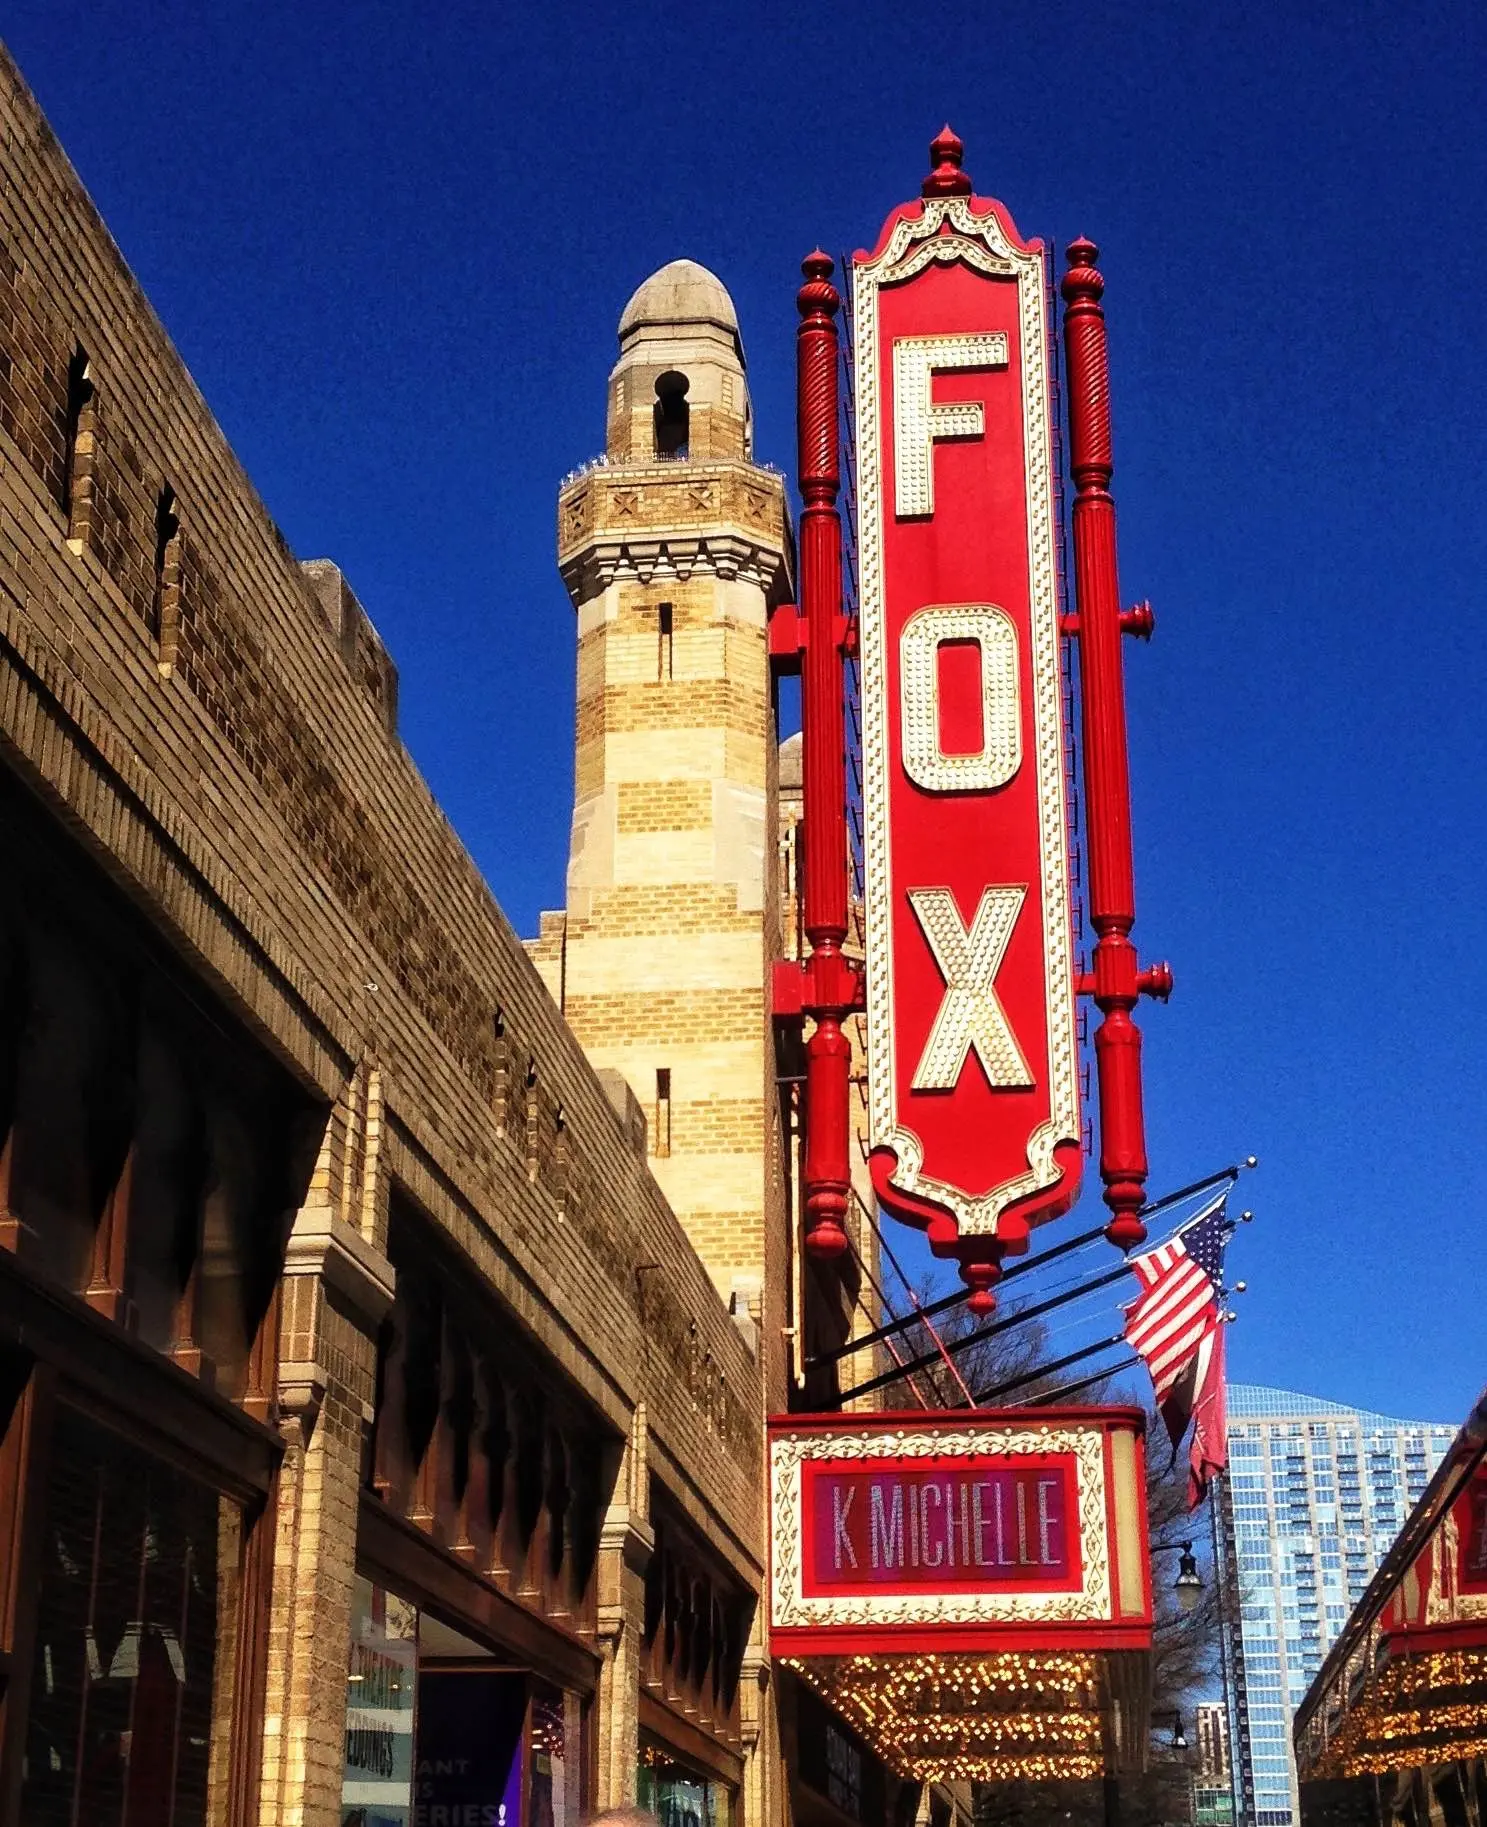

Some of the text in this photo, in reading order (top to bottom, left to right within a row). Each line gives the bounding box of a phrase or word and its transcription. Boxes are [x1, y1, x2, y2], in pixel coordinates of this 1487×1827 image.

[891, 333, 1036, 1091] FOX
[832, 1480, 1062, 1569] K MICHELLE
